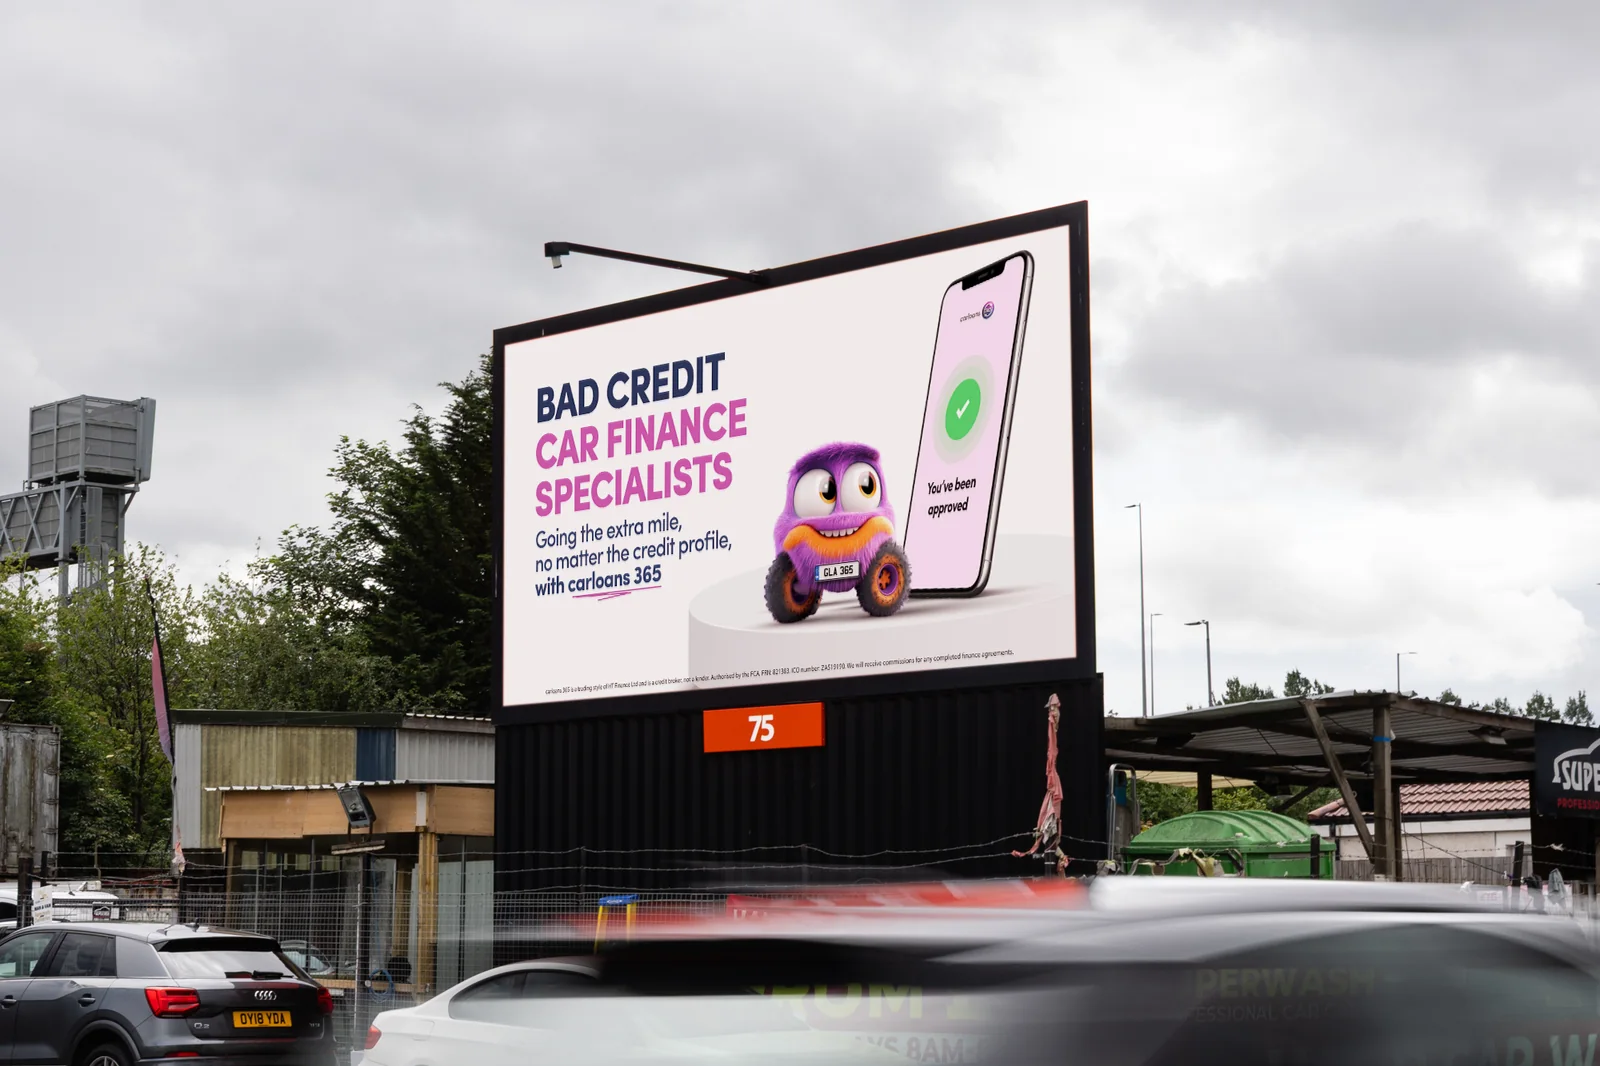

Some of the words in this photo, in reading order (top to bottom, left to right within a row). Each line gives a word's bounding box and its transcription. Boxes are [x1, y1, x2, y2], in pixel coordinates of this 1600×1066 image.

[537, 378, 599, 424] BAD
[607, 352, 726, 409] CREDIT
[535, 425, 599, 470] CAR
[607, 398, 747, 458] FINANCE
[535, 451, 733, 517] SPECIALISTS
[928, 480, 953, 495] You've
[955, 477, 977, 491] been
[928, 496, 969, 518] approved
[536, 528, 577, 550] Going
[581, 523, 603, 543] the
[606, 519, 644, 539] extra
[648, 512, 682, 533] mile,
[536, 558, 553, 572] no
[556, 549, 604, 570] matter
[606, 544, 629, 563] the
[633, 536, 675, 560] credit
[679, 529, 732, 560] profile,
[535, 575, 565, 597] with
[568, 571, 630, 592] carloans
[634, 564, 662, 584] 365
[823, 567, 837, 577] GLA
[840, 565, 854, 575] 365
[883, 658, 914, 666] commissions
[934, 653, 961, 662] completed
[962, 651, 980, 659] finance
[982, 649, 1014, 659] agreements.
[748, 714, 775, 742] 75
[240, 1012, 264, 1025] OY18
[266, 1012, 286, 1025] YDA
